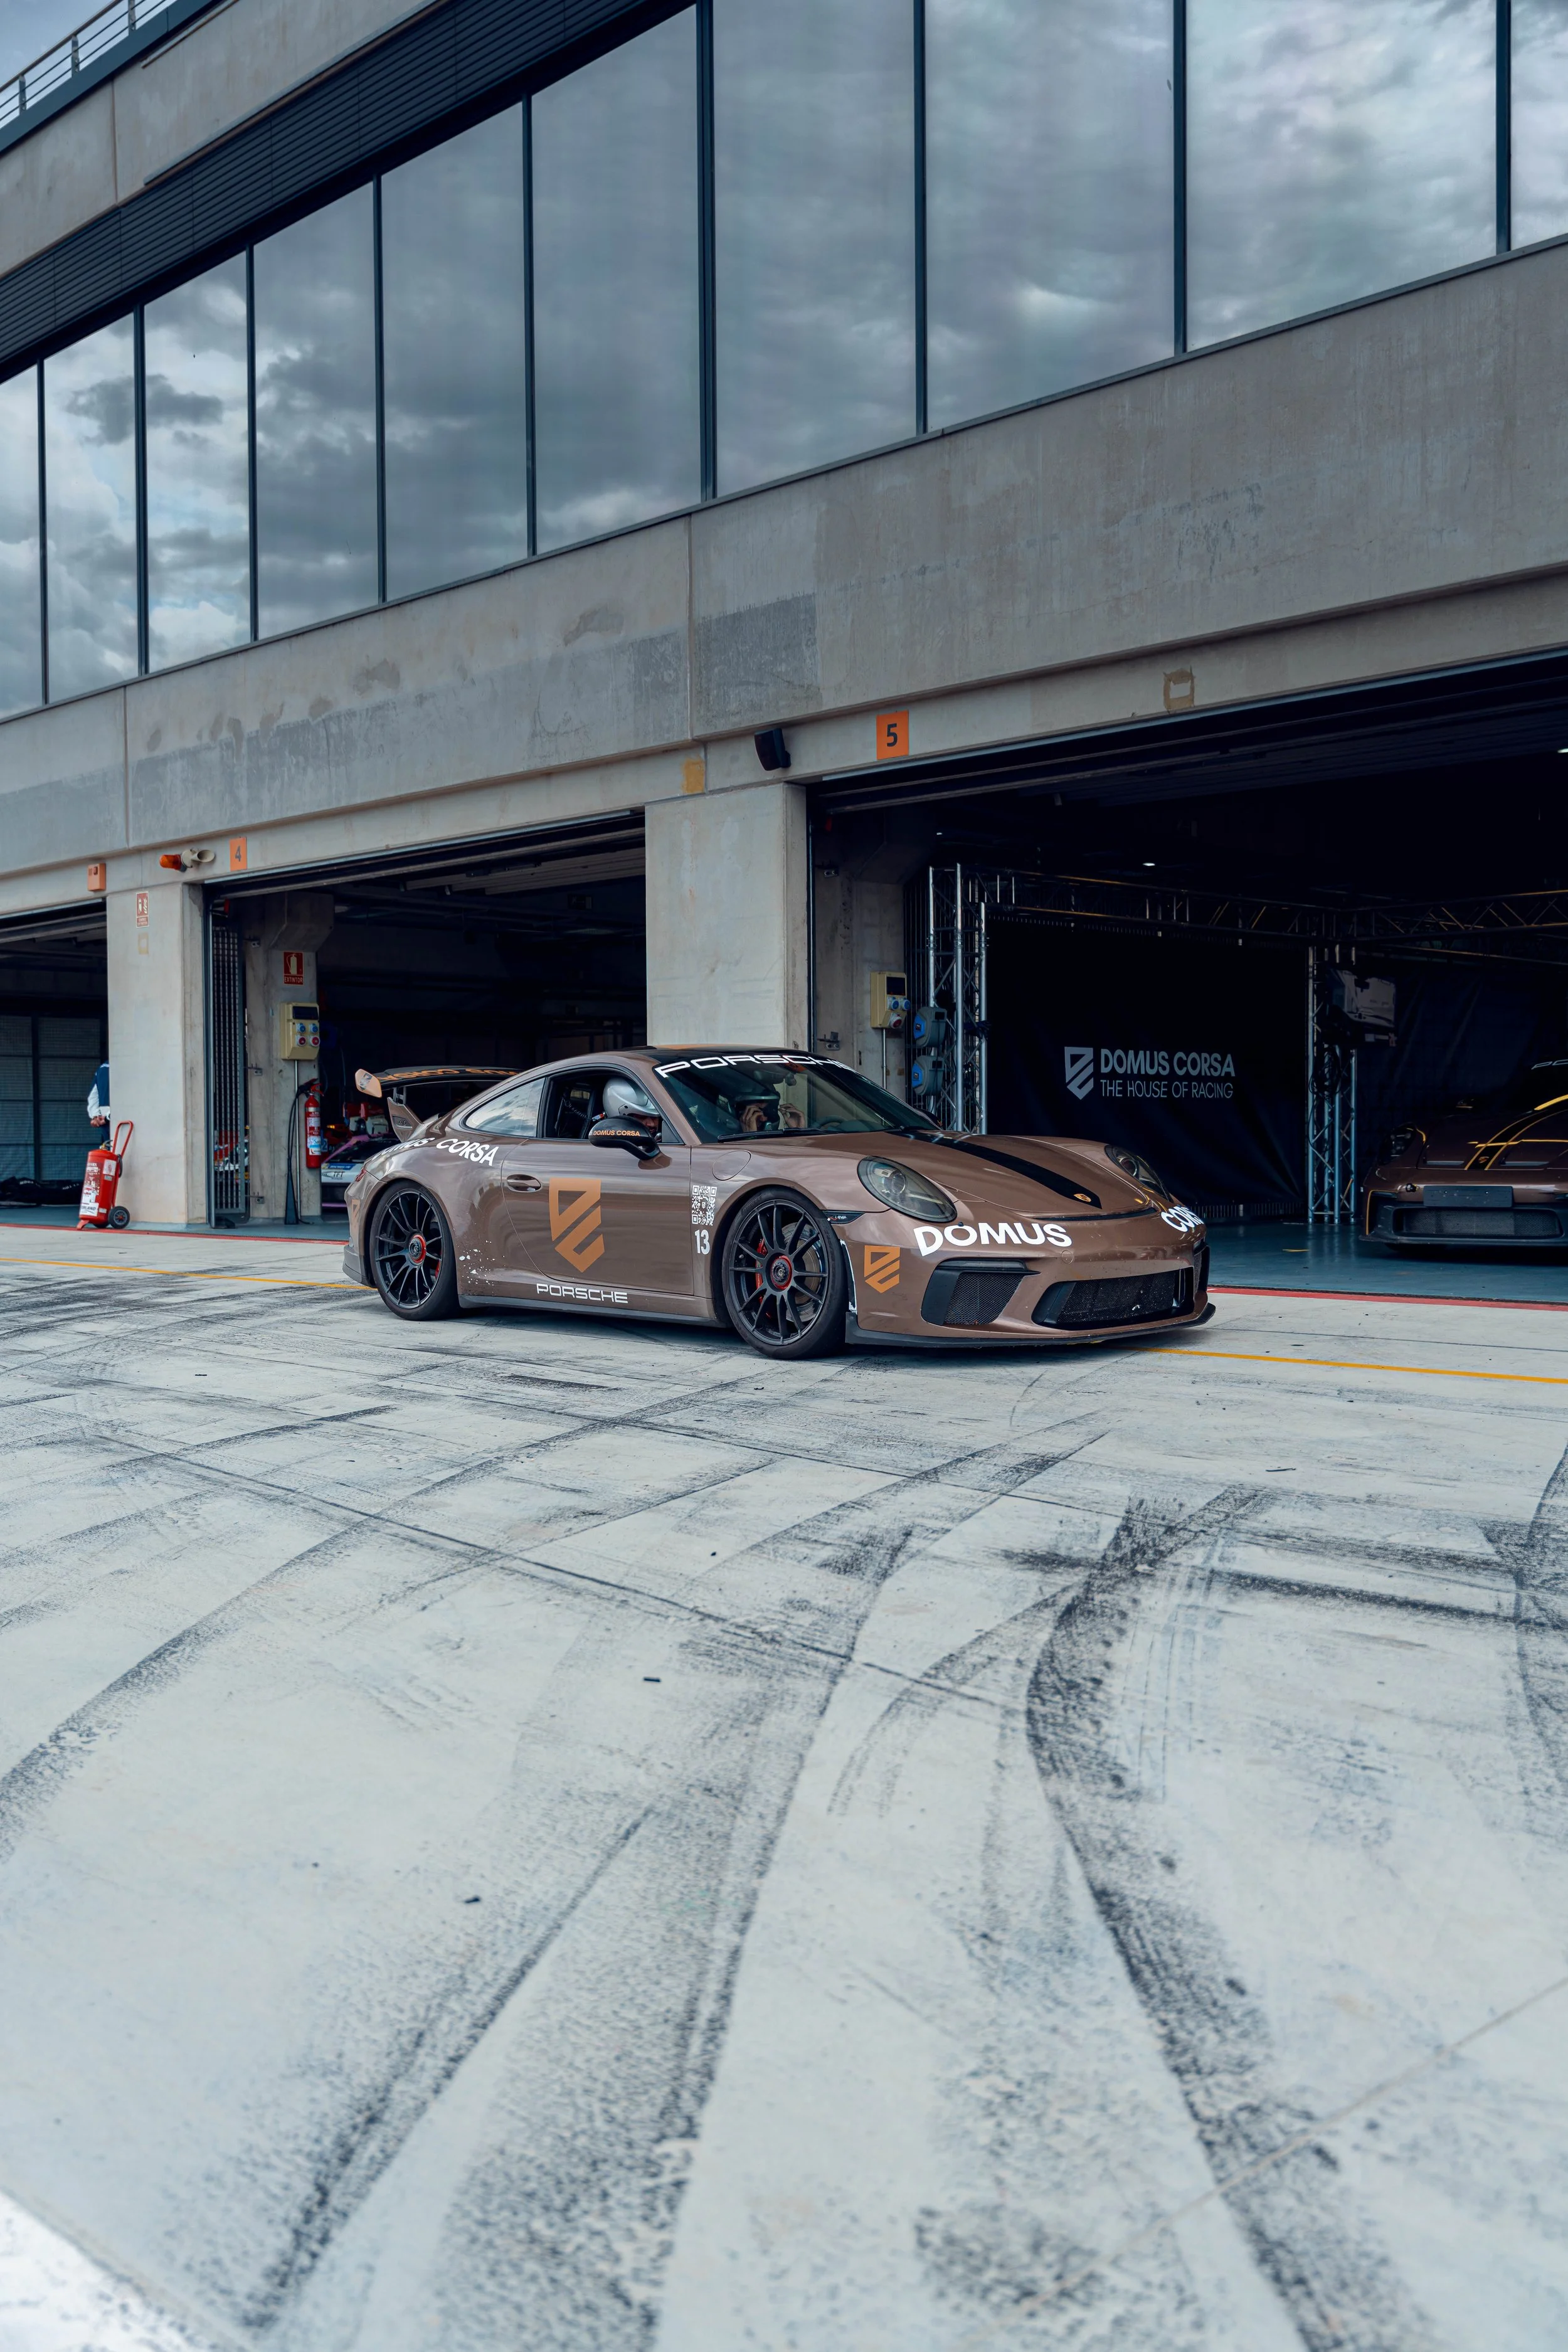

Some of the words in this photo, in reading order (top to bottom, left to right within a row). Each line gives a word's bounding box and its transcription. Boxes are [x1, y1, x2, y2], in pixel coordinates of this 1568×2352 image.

[887, 723, 898, 747] 5
[235, 845, 241, 862] 4
[654, 1055, 852, 1078] PORSCHE
[1101, 1048, 1170, 1076] DOMUS
[1173, 1051, 1236, 1077] CORSA
[1100, 1079, 1123, 1097] THE
[1127, 1080, 1167, 1098] HOUSE
[1172, 1081, 1189, 1098] OF
[1192, 1082, 1234, 1099] RACING
[436, 1138, 499, 1167] CORSA
[1161, 1206, 1204, 1232] CORS
[694, 1229, 711, 1255] 13
[913, 1222, 1073, 1257] DOMUS
[536, 1283, 628, 1304] PORSCHE
